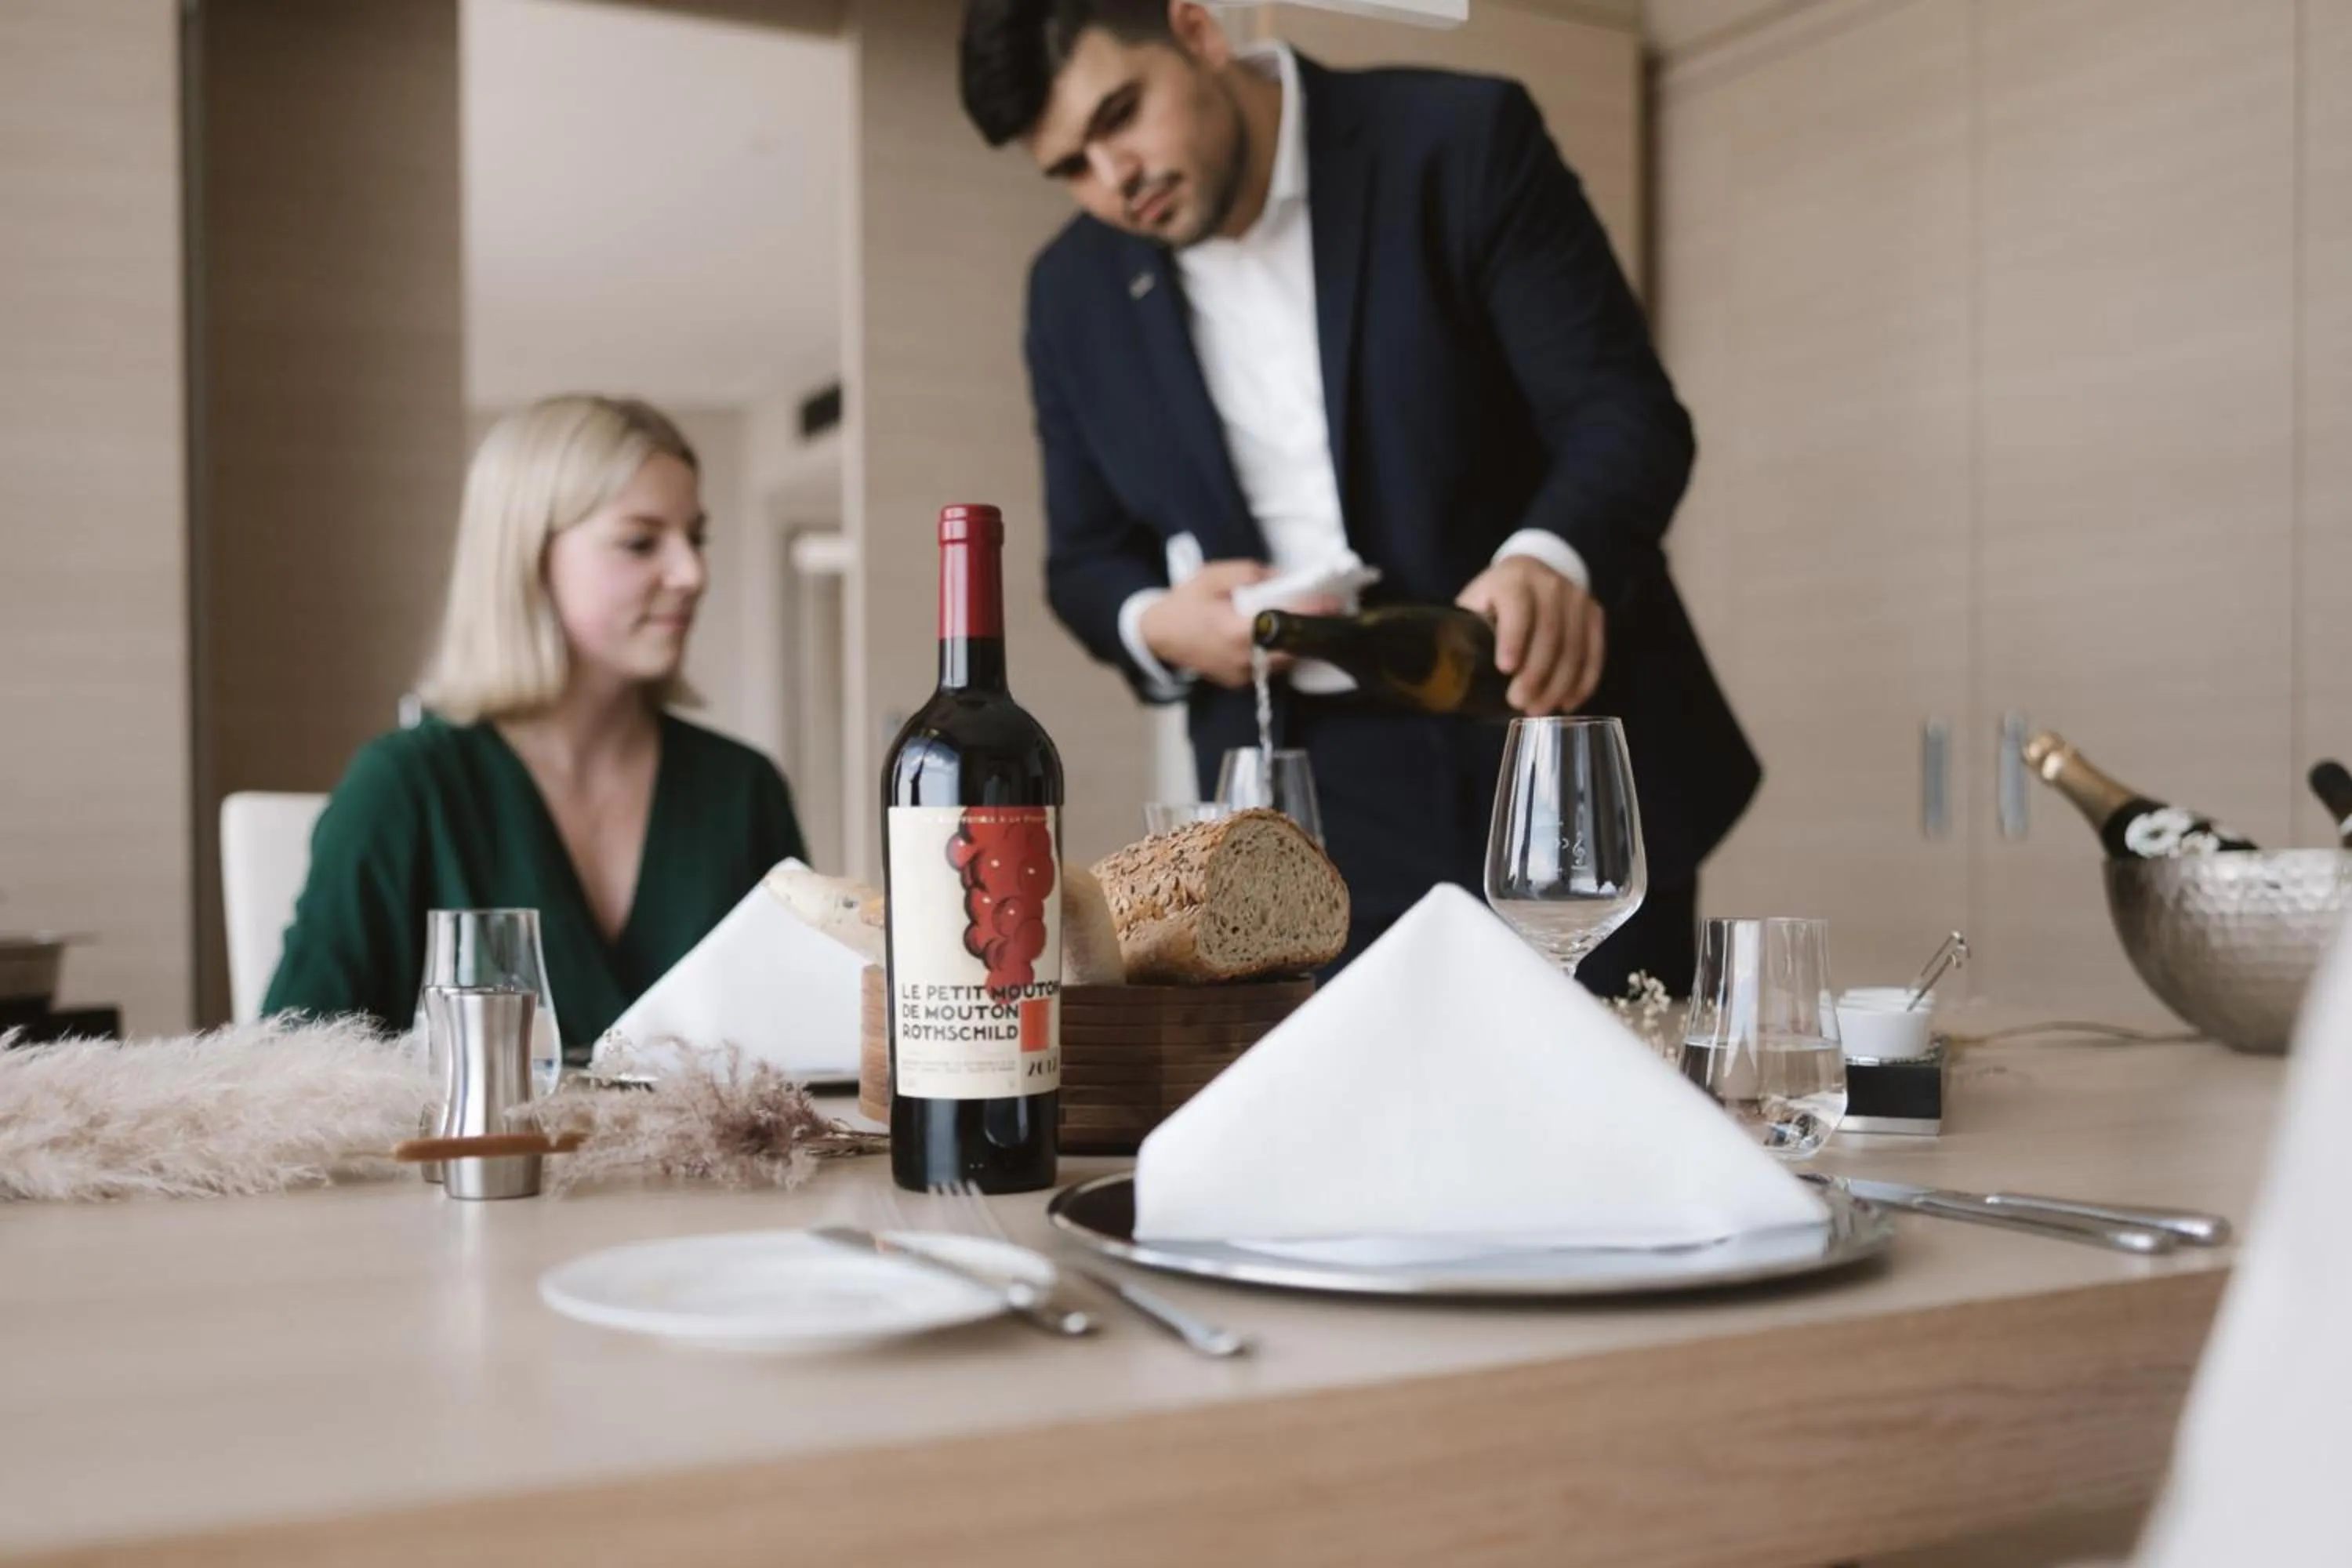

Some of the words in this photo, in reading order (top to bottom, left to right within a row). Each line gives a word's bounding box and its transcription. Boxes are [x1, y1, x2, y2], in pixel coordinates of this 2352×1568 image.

[902, 983, 920, 1000] LE
[927, 985, 986, 1000] PETIT
[903, 1004, 920, 1019] DE
[925, 1004, 1018, 1020] MOUTON
[902, 1024, 1018, 1041] ROTHSCHILD
